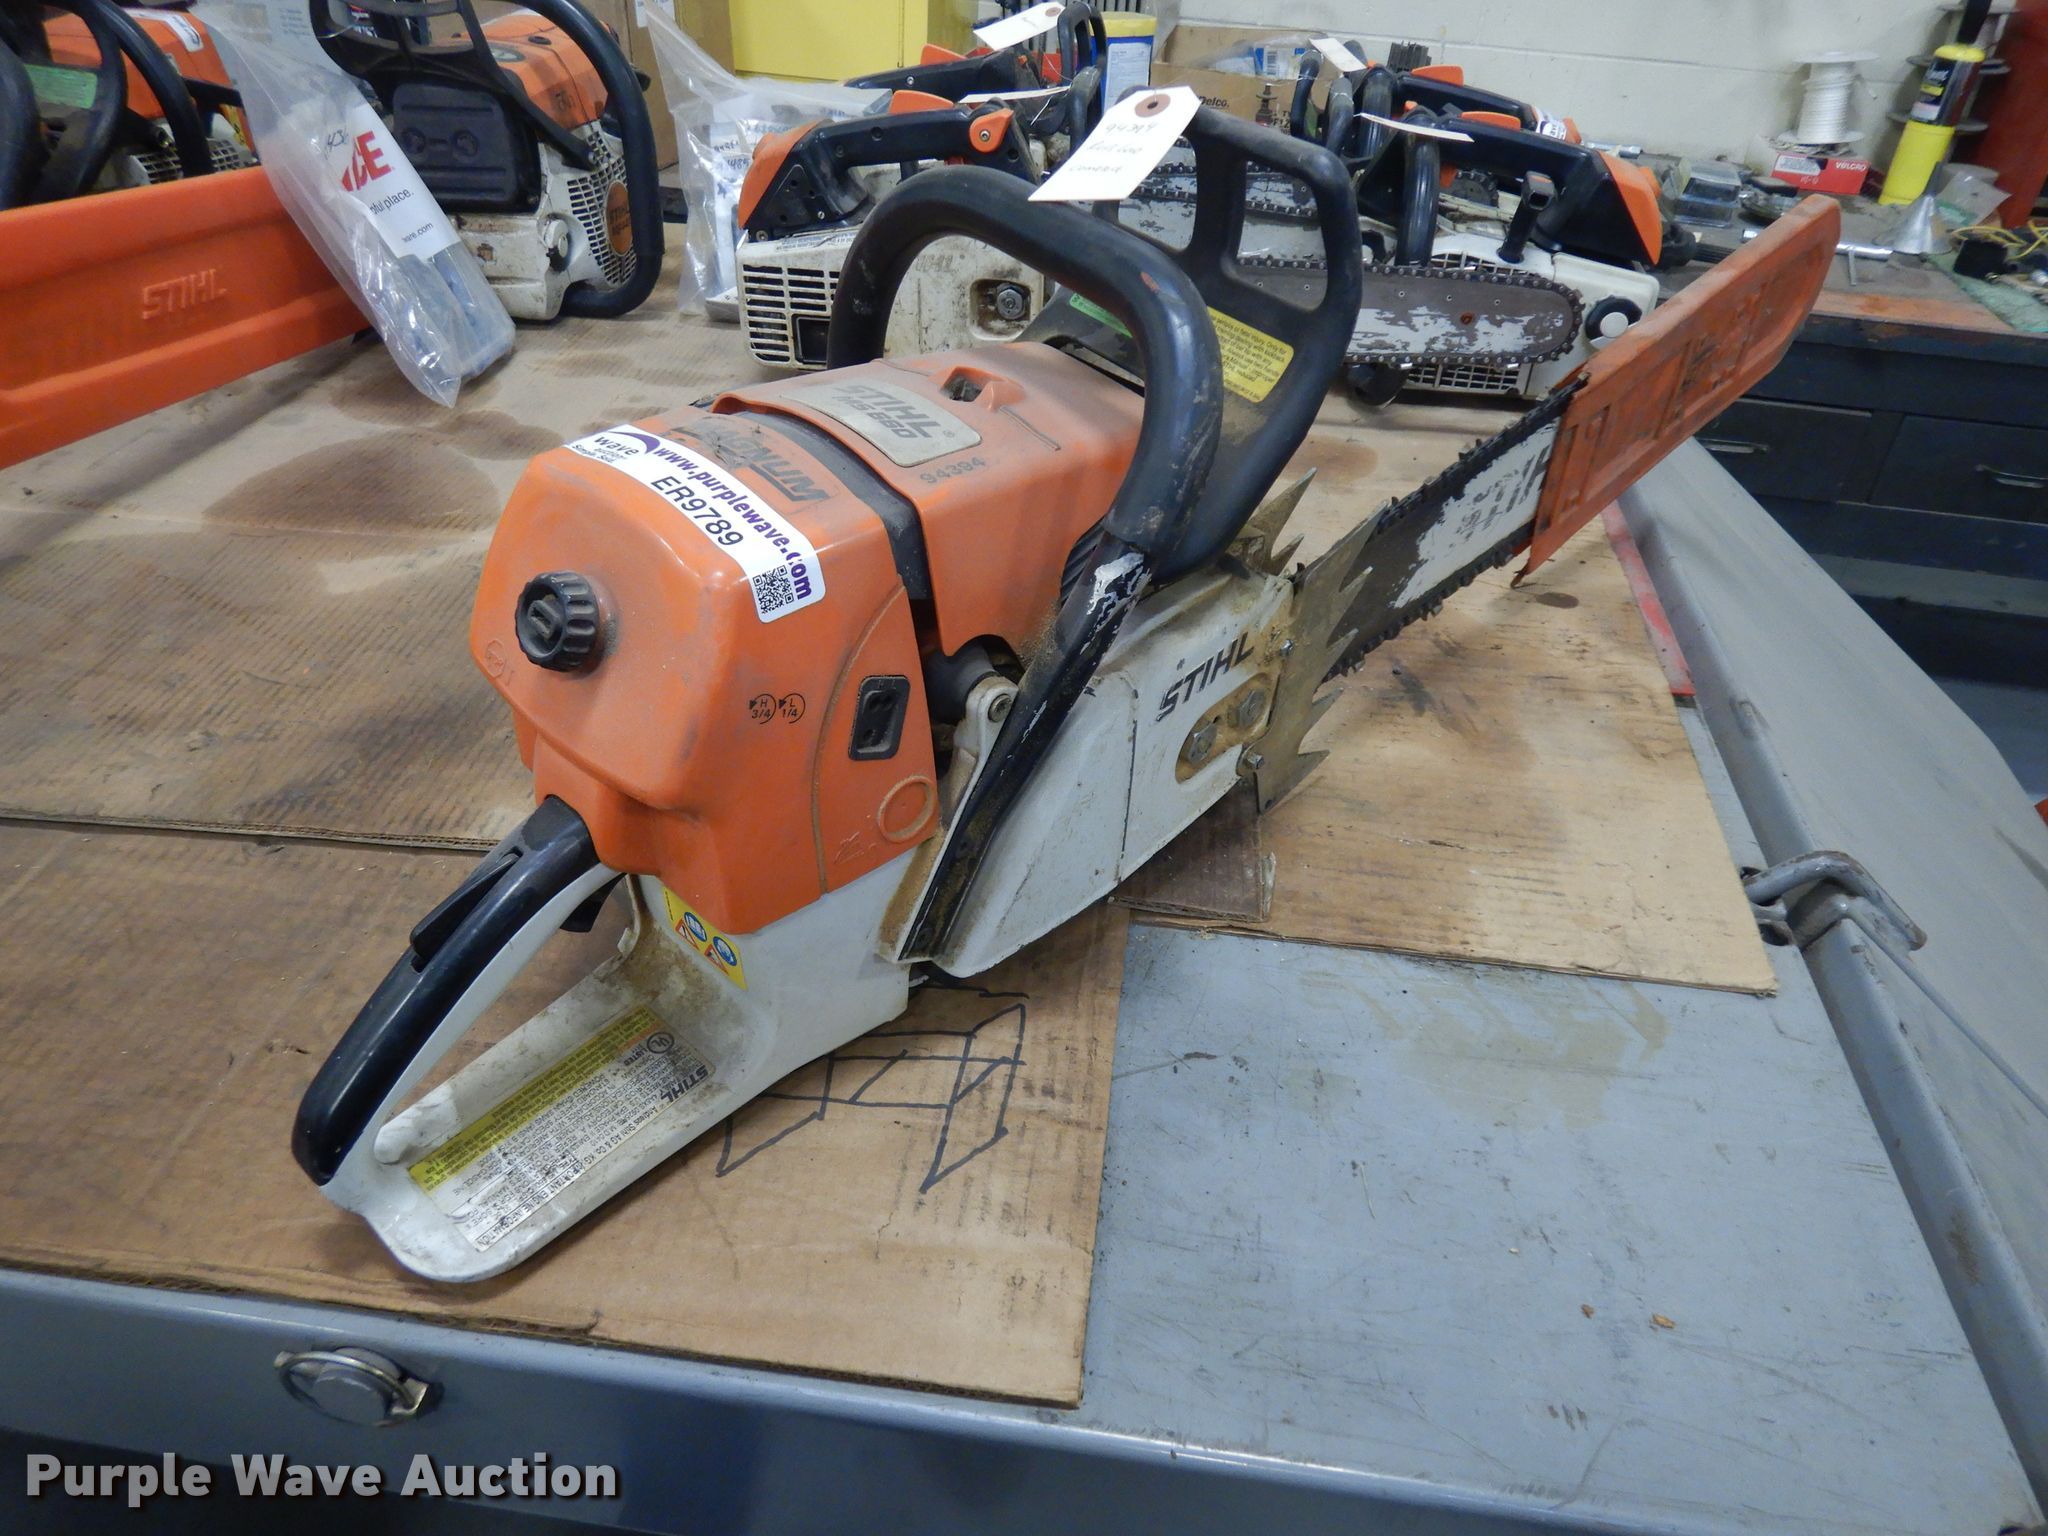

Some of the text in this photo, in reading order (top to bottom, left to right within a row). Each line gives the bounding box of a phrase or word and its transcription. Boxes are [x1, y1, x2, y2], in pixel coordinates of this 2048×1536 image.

[142, 268, 227, 320] STIHL
[834, 384, 941, 438] STIHL
[868, 411, 918, 438] 660
[594, 436, 640, 456] wave
[919, 456, 986, 485] 94394
[650, 475, 744, 547] ER9789
[653, 447, 812, 600] www.purplewave.com
[1156, 631, 1255, 722] STIHL
[622, 1045, 648, 1068] LISTED
[659, 1063, 711, 1107] STIHL
[608, 1131, 623, 1145] AG
[520, 1188, 549, 1213] ENGINE
